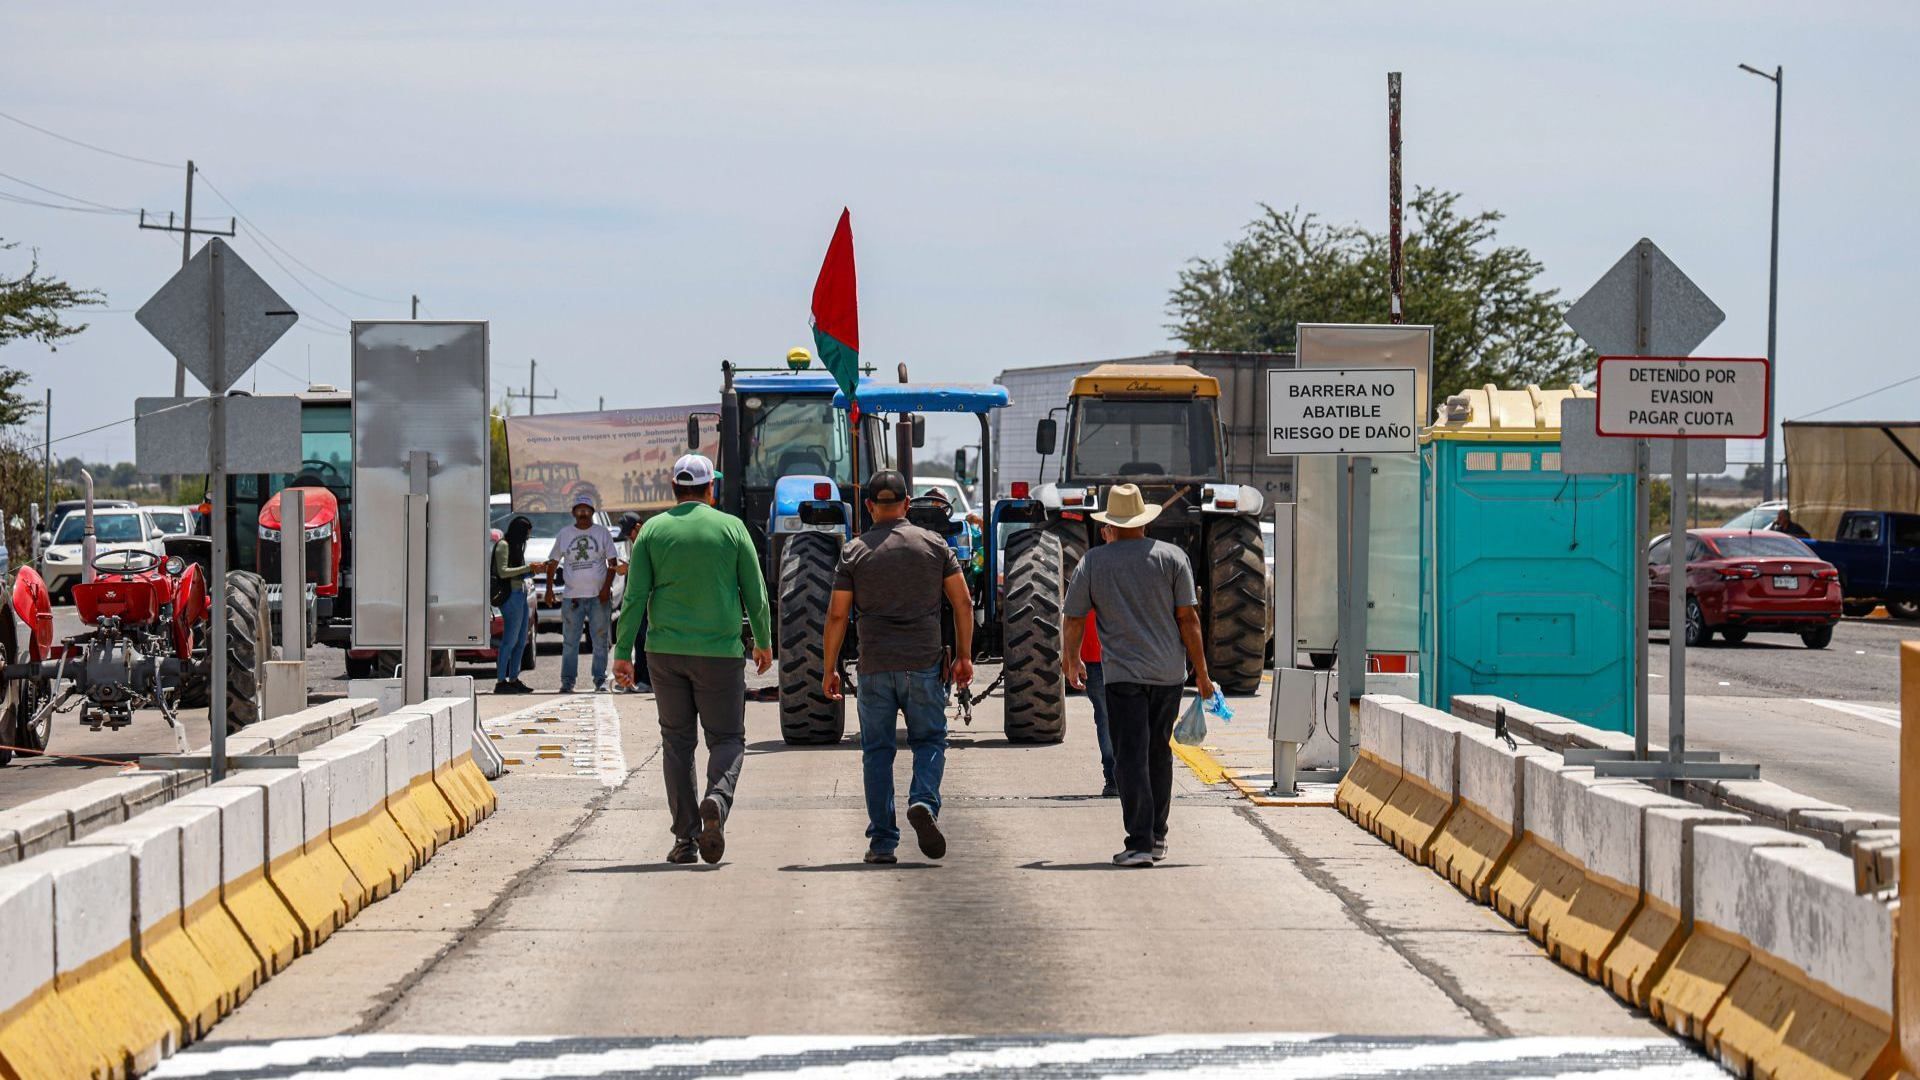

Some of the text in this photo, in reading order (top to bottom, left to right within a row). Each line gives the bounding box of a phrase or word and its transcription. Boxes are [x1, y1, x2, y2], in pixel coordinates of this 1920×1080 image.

[1629, 368, 1736, 384] DETENIDO POR
[1289, 383, 1395, 398] BARRERA NO
[1651, 389, 1713, 404] EVASION
[1302, 405, 1381, 419] ABATIBLE
[1629, 410, 1734, 426] PAGAR CUOTA
[1273, 423, 1411, 440] RIESGO DE DAÑO
